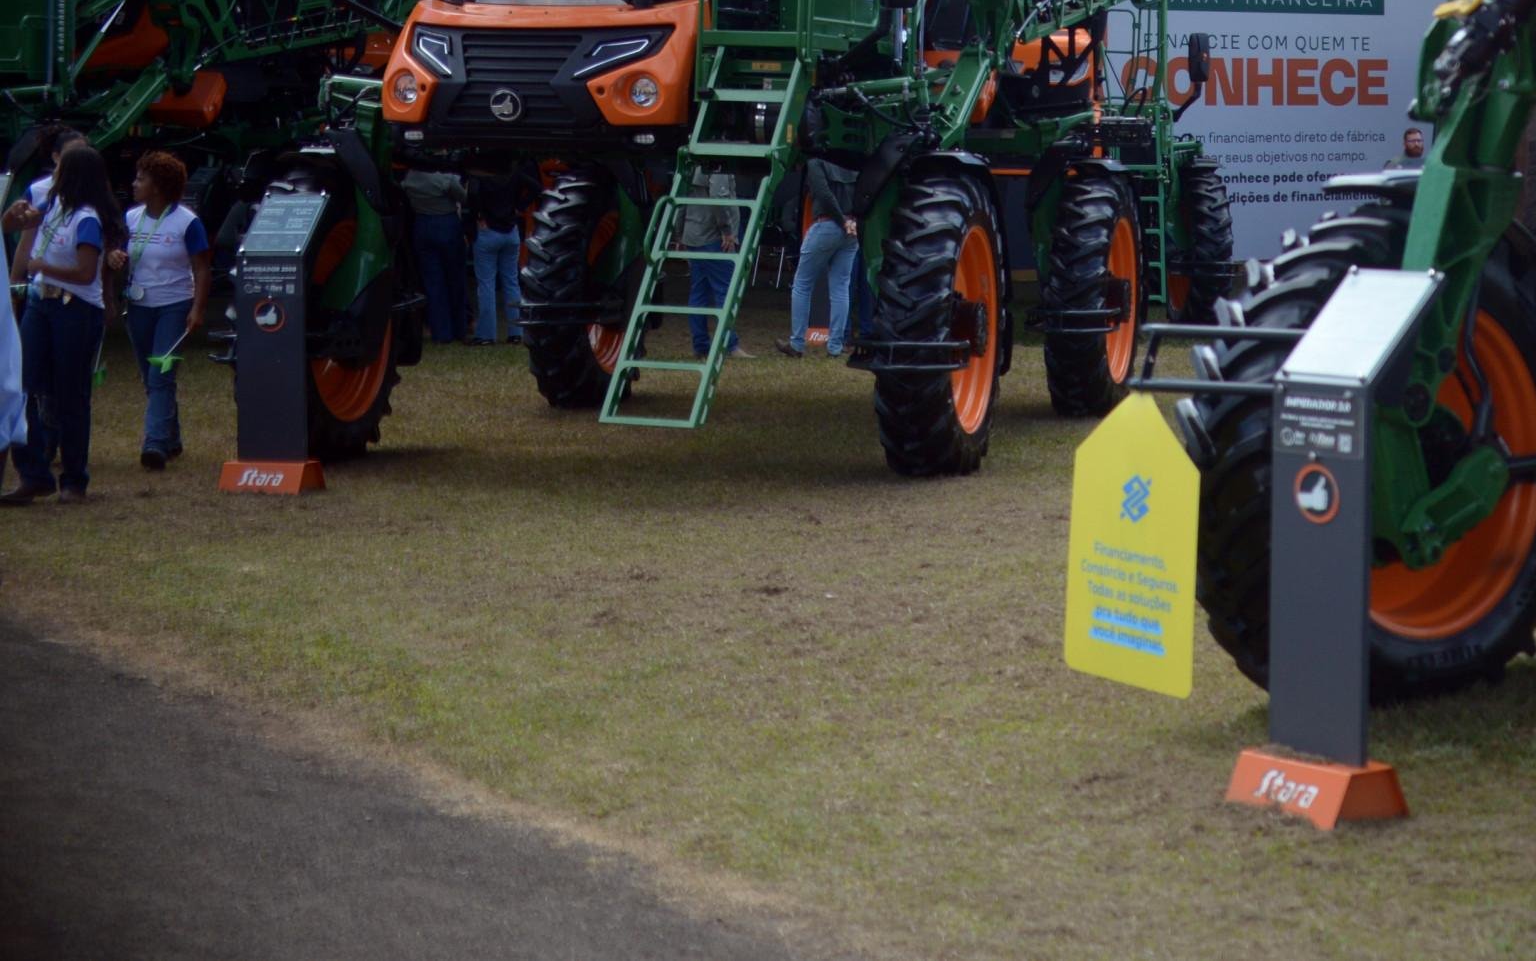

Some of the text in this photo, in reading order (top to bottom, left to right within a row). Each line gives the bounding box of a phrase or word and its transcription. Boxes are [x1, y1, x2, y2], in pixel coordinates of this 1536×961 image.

[1247, 34, 1289, 51] COM
[1294, 34, 1346, 54] QUEM
[1351, 36, 1371, 52] TE
[1120, 55, 1389, 107] CONHECE
[1208, 130, 1292, 144] financiamento
[1294, 131, 1328, 143] direto
[1330, 130, 1344, 143] de
[1346, 129, 1386, 143] fábrica
[1225, 153, 1254, 164] seus
[1256, 150, 1309, 166] objetivos
[1310, 152, 1325, 162] no
[1327, 151, 1368, 164] campo.
[1273, 171, 1304, 186] pode
[1272, 191, 1288, 203] de
[237, 467, 284, 488] Stara
[1253, 769, 1319, 809] Stara
